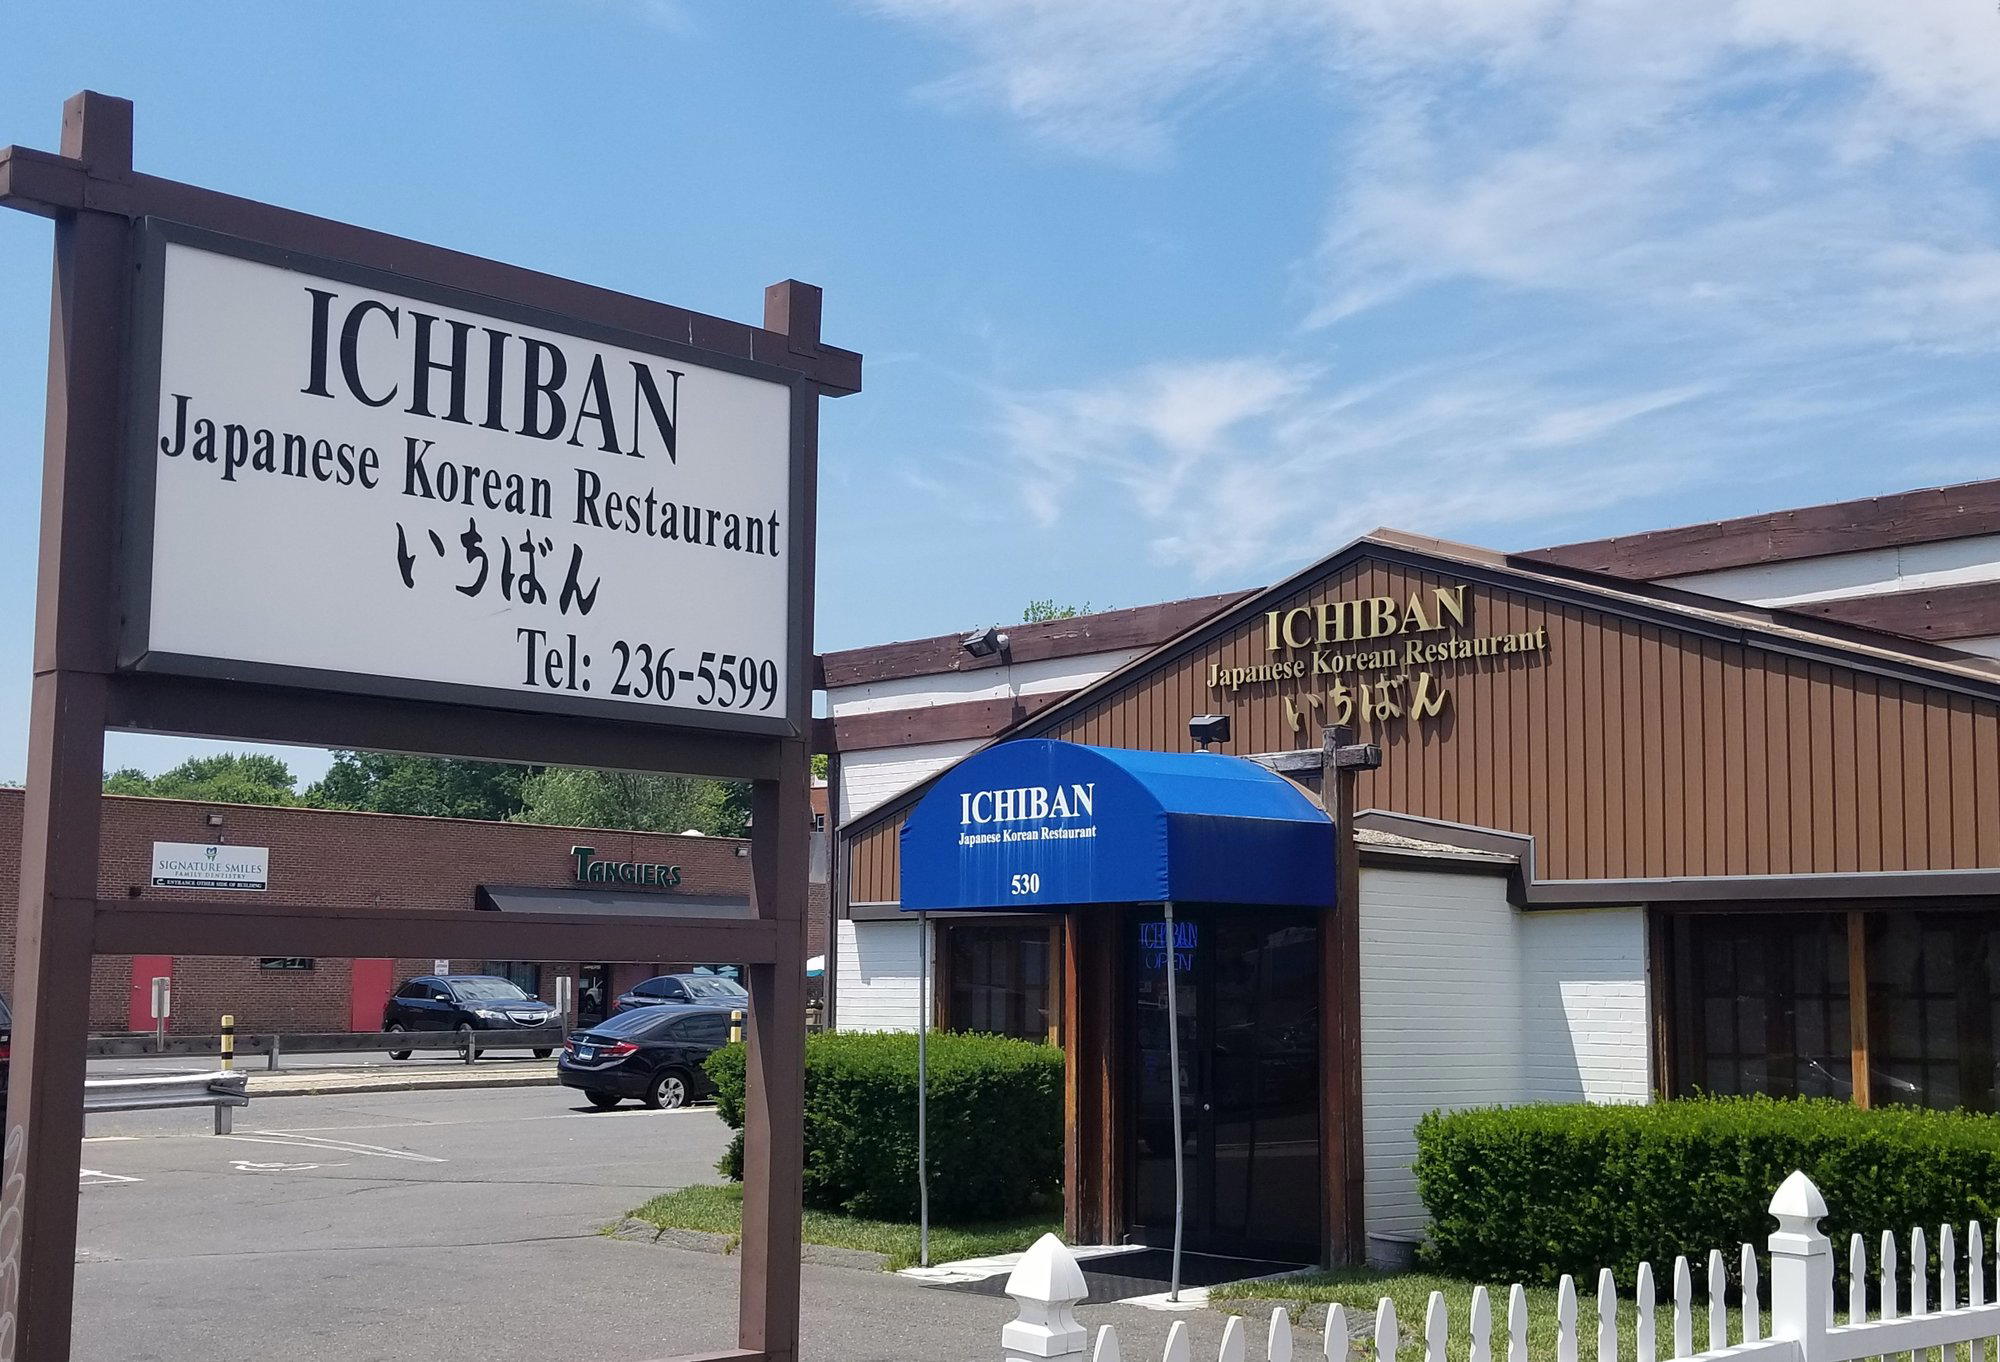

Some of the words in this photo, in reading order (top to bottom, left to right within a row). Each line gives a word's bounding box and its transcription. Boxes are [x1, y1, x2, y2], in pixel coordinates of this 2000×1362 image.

[301, 286, 684, 465] ICHIBAN
[161, 394, 379, 489] Japanese
[402, 436, 552, 519] Korean
[573, 468, 780, 557] Restaurant
[396, 517, 600, 616] いちばん
[1265, 584, 1467, 650] ICHIBAN
[517, 627, 590, 691] Tel:
[610, 640, 778, 711] 236-5599
[1206, 660, 1305, 691] Japanese
[1311, 648, 1397, 675] Korean
[1404, 625, 1546, 665] Restaurant
[1284, 671, 1446, 732] いちばん
[960, 783, 1095, 825] ICHIBAN
[159, 860, 222, 872] SIGNATURE
[225, 864, 263, 873] SMILES
[571, 846, 682, 887] TANGIERS
[958, 832, 1001, 847] Japanese
[1003, 828, 1039, 842] Korean
[1041, 825, 1097, 840] Restaurant
[1011, 873, 1040, 894] 530
[1139, 922, 1198, 948] ICHBAN
